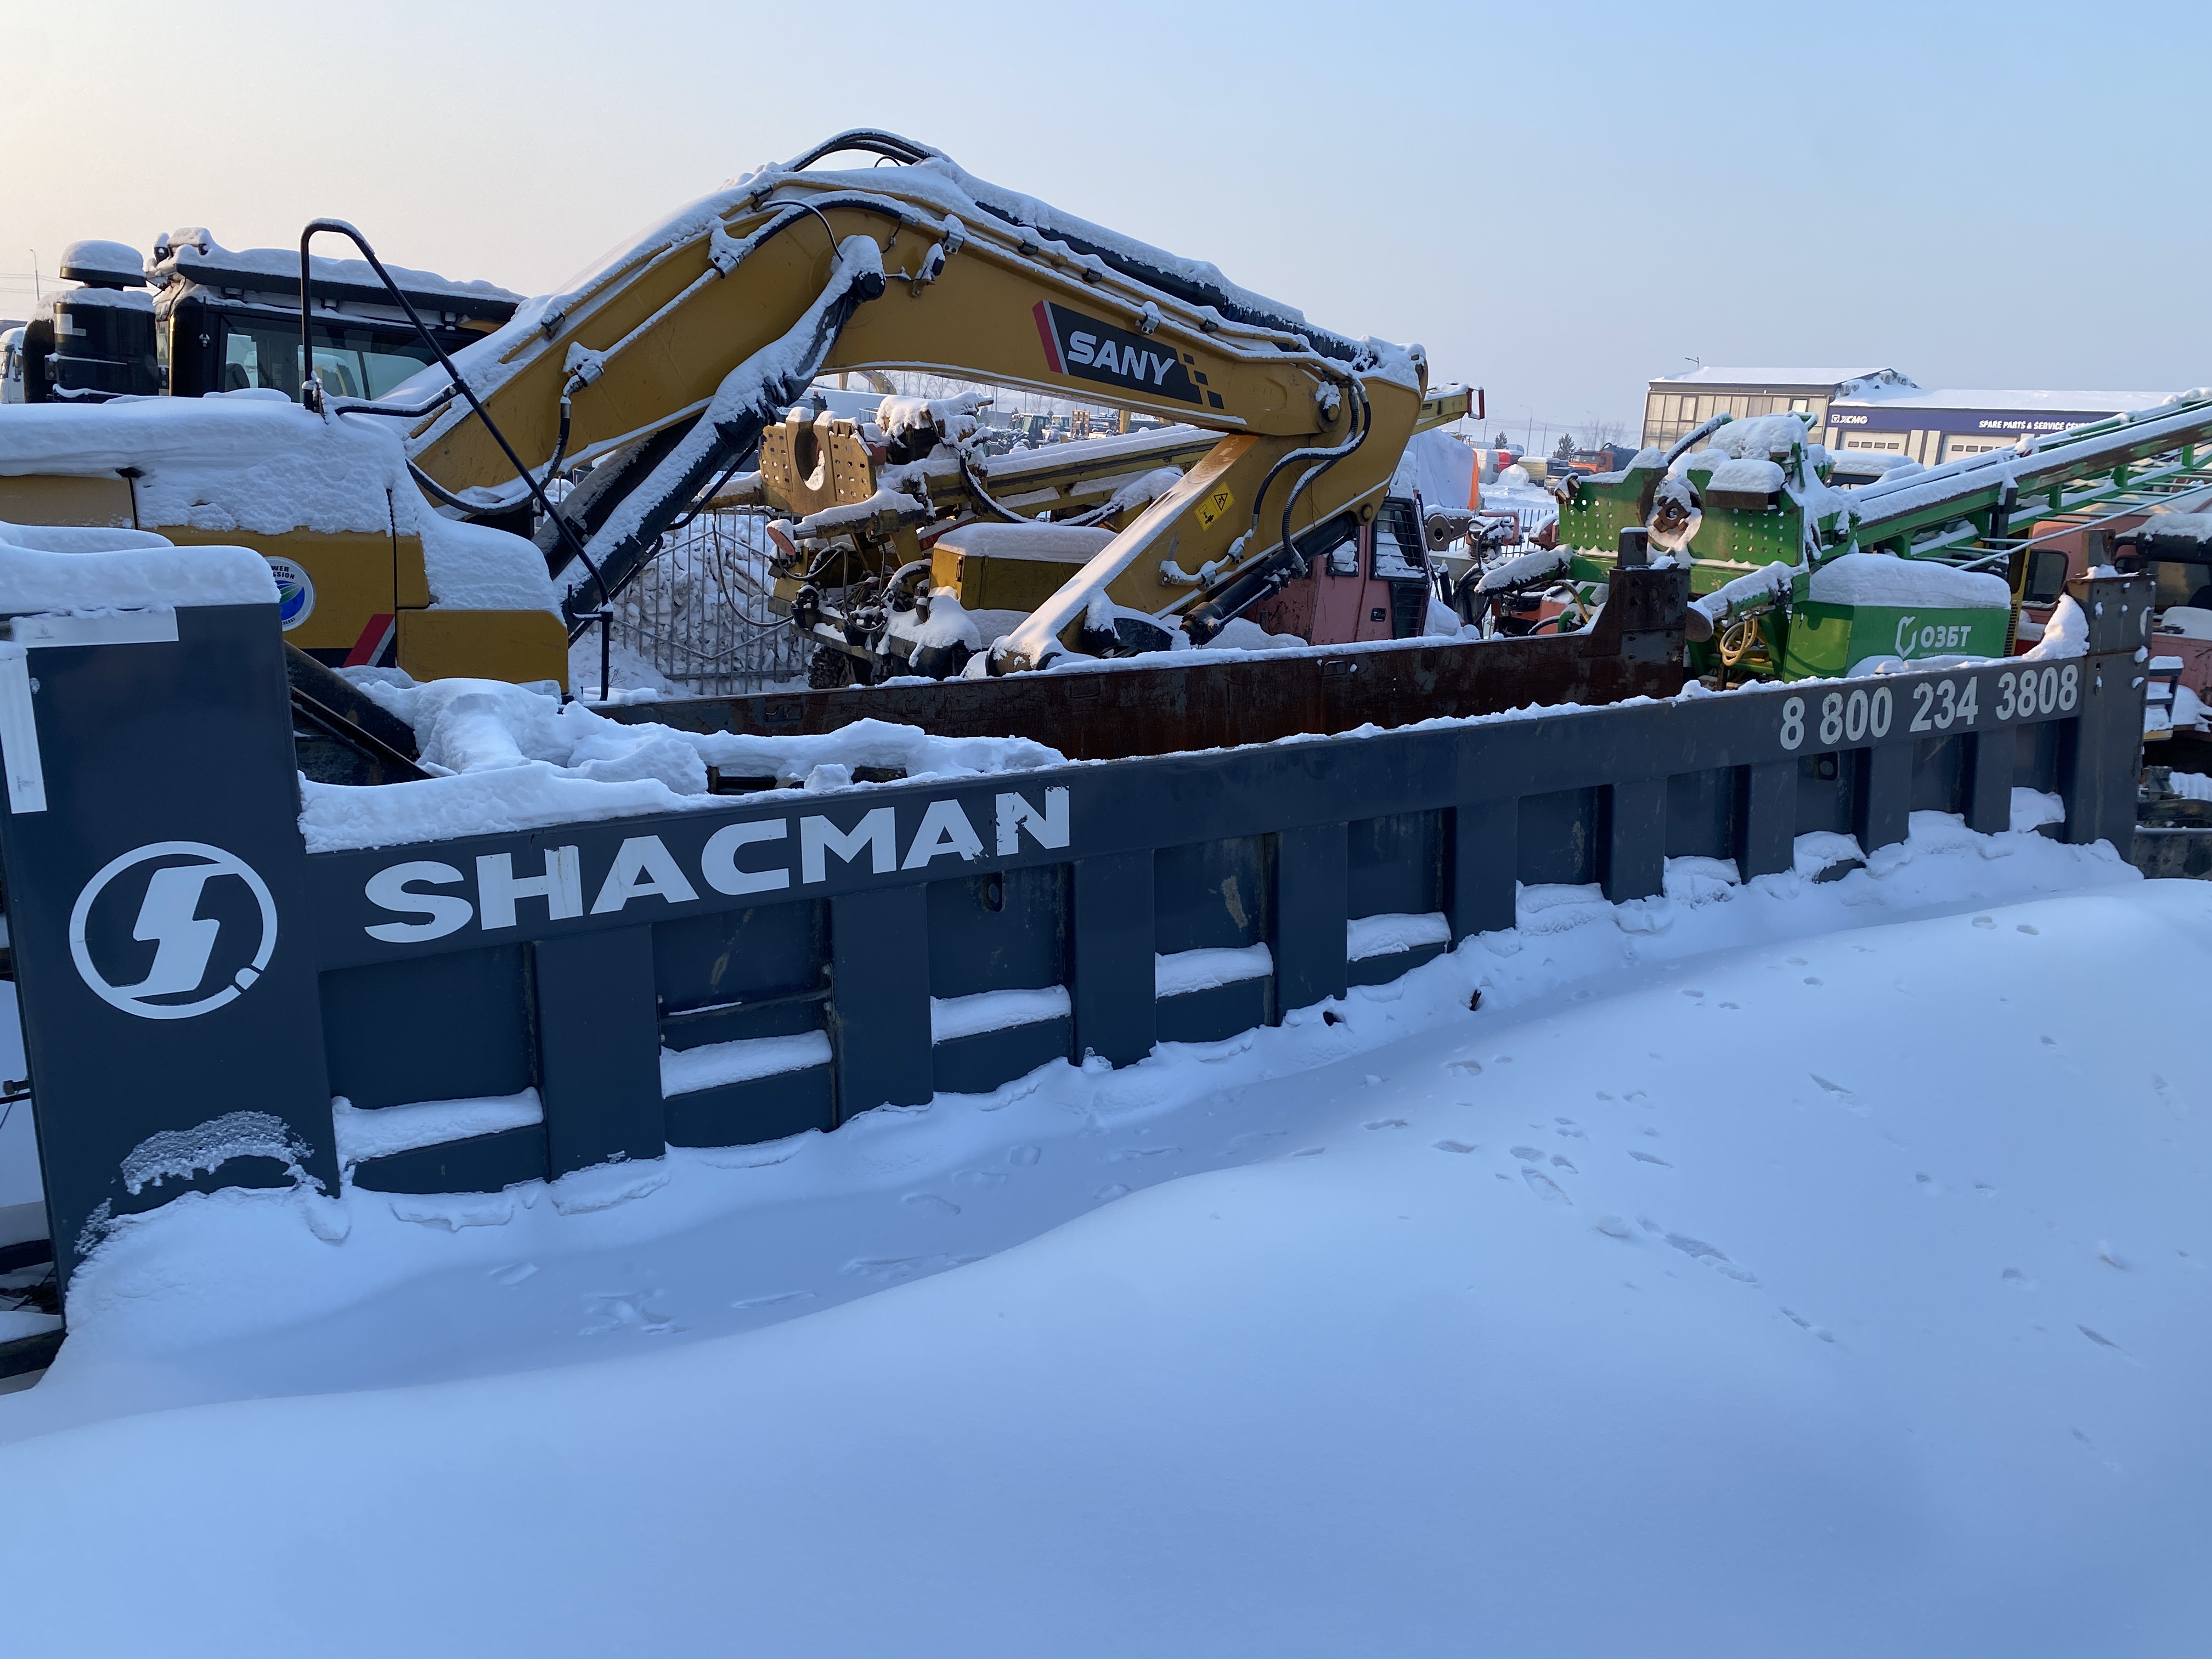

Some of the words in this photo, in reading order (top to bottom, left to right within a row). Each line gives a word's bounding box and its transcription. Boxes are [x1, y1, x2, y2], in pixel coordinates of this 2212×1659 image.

[1068, 330, 1176, 386] SANY
[1839, 415, 1868, 424] XCMG
[1979, 420, 2002, 428] SPARE
[2003, 420, 2026, 430] PARTS
[2033, 421, 2064, 431] SERVICE
[283, 617, 296, 625] NERGY
[1921, 625, 1972, 648] ОЗБТ
[1780, 696, 1805, 750] 8
[1819, 686, 1893, 745] 800
[1909, 676, 1979, 733] 234
[1995, 664, 2079, 720] 3808
[363, 785, 1070, 944] SHACMAN
